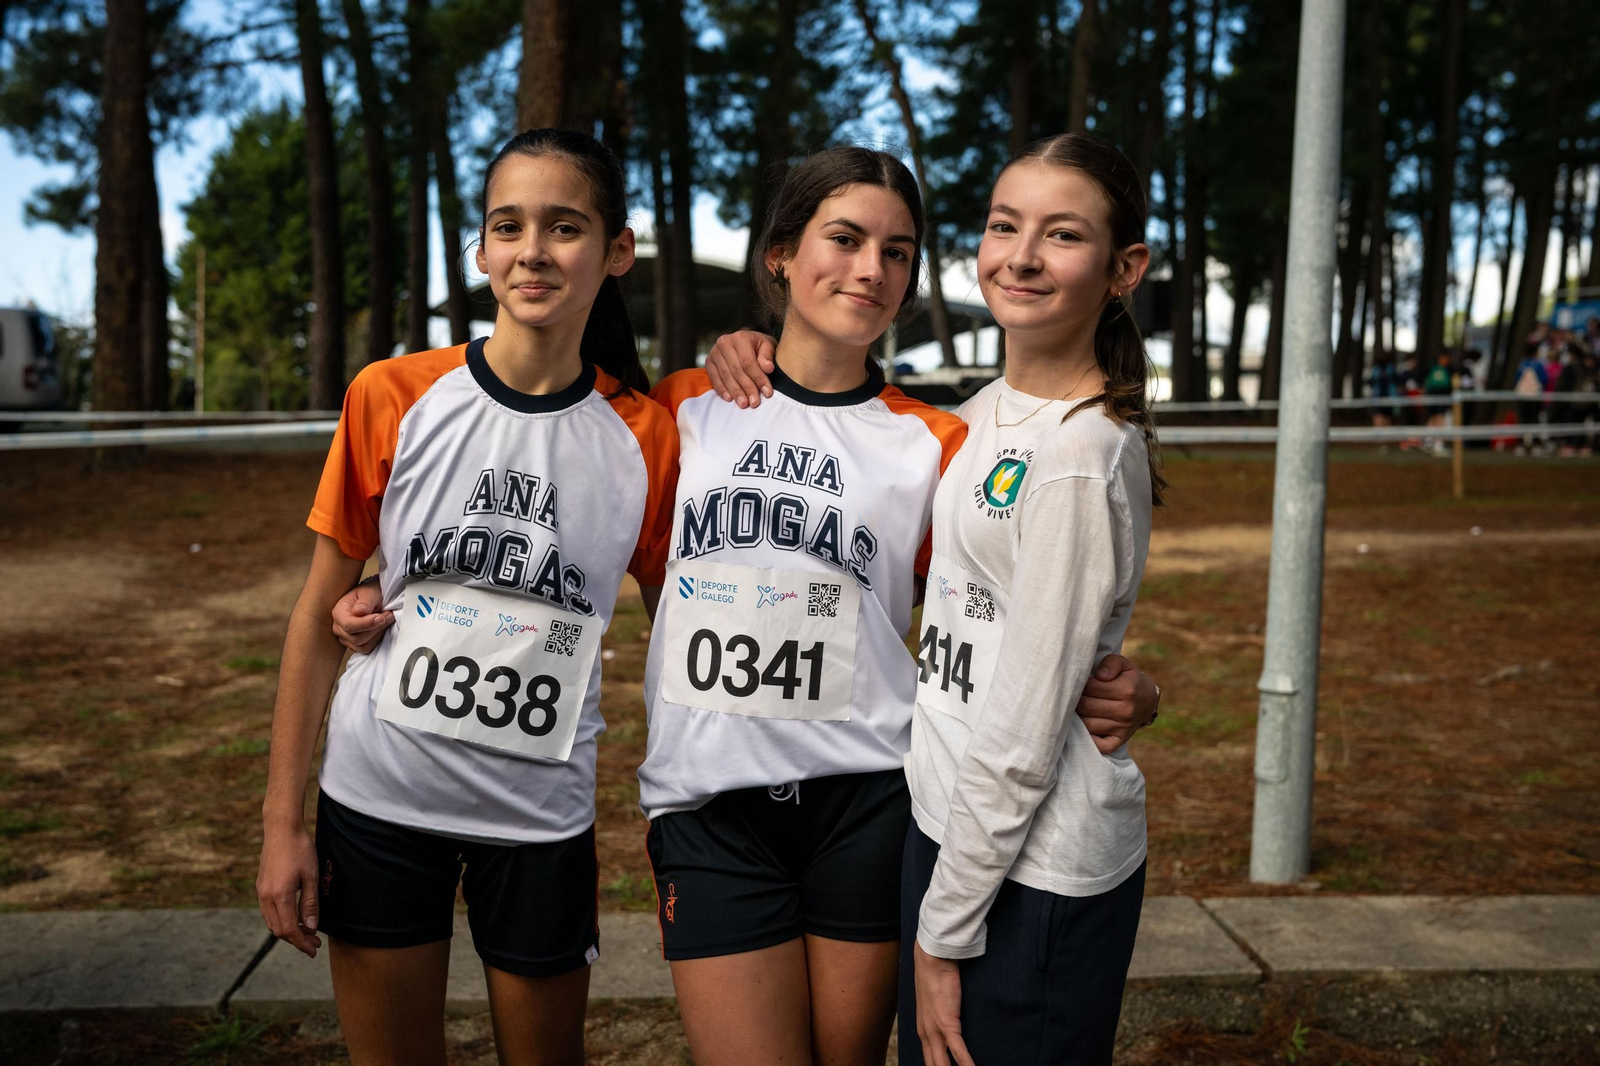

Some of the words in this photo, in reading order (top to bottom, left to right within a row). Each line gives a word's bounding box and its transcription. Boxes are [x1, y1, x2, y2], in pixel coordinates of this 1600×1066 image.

[732, 440, 844, 497] ANA
[974, 483, 986, 509] LUIS
[463, 469, 558, 531] ANA
[676, 486, 877, 591] MOGAS
[402, 526, 597, 617] MOGAS
[701, 580, 738, 593] DEPORTE
[701, 591, 735, 604] GALEGO
[437, 612, 473, 628] GALEGO
[440, 601, 479, 618] DEPORTE
[398, 646, 562, 737] 0338
[686, 628, 825, 701] 0341
